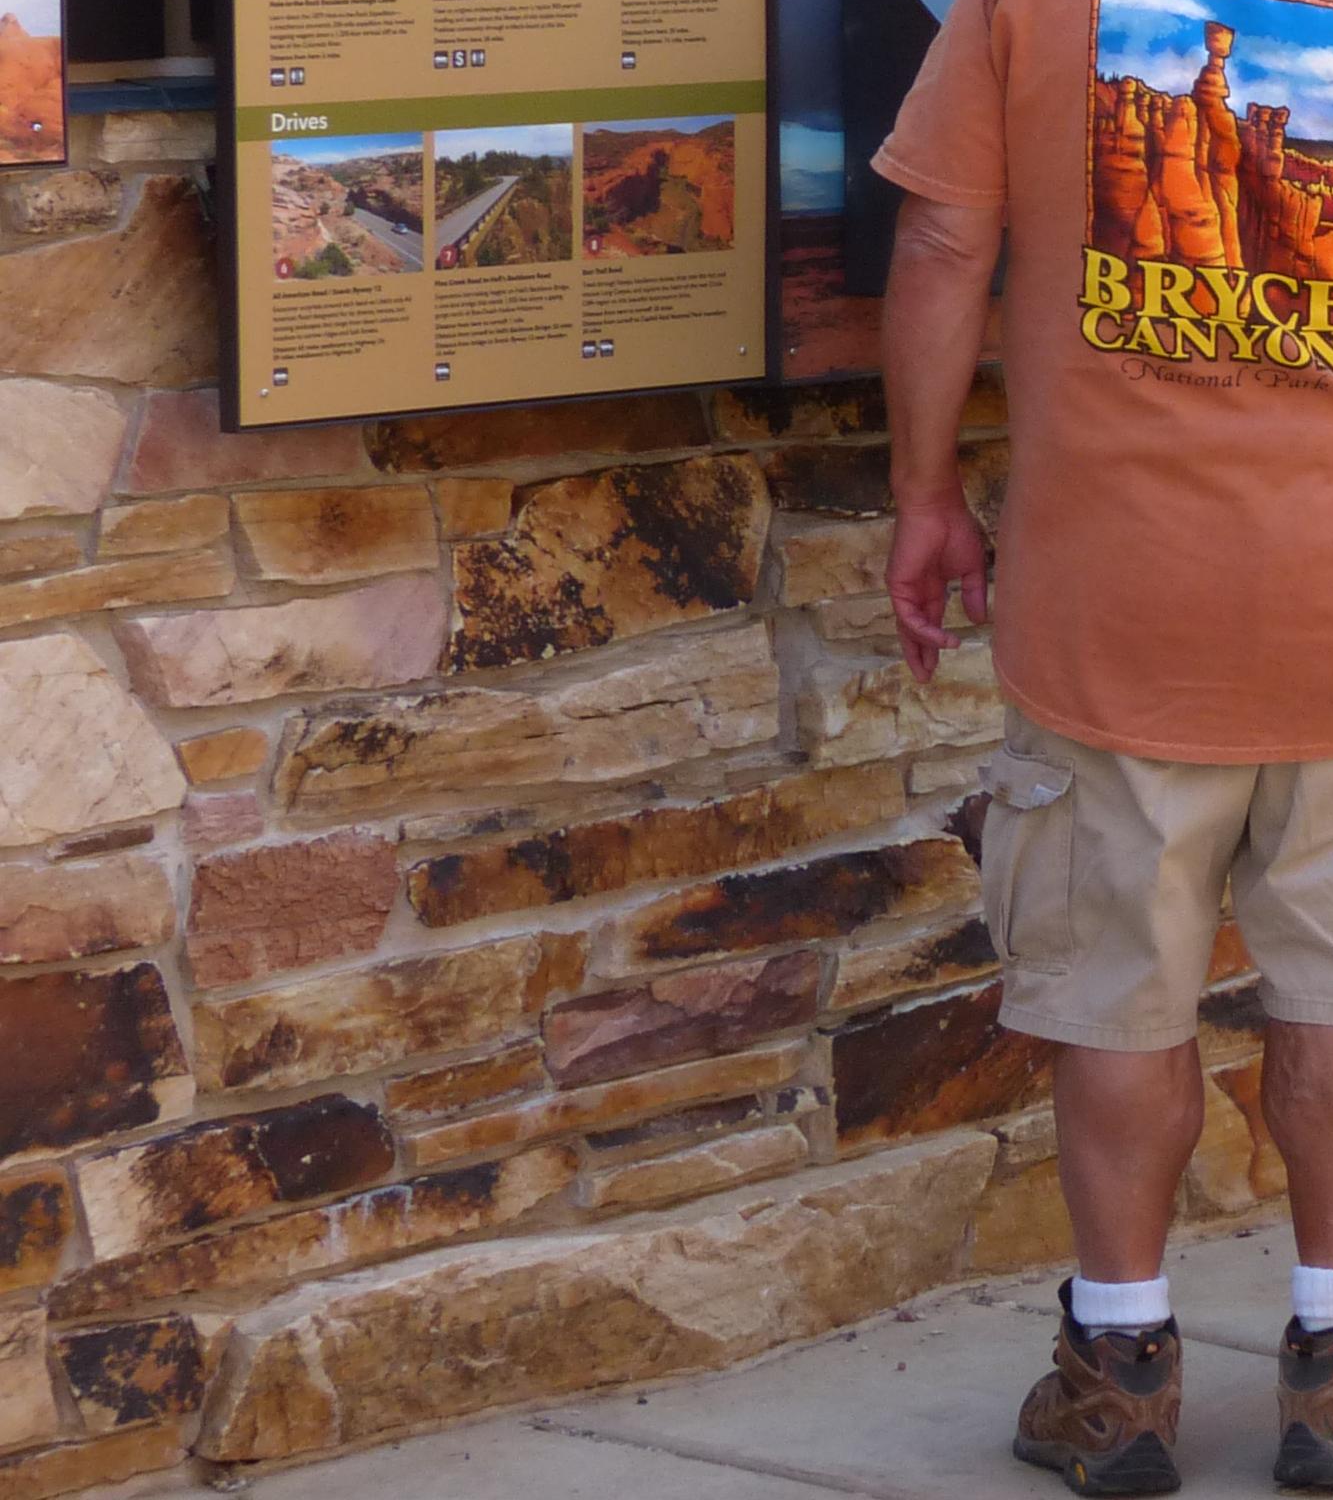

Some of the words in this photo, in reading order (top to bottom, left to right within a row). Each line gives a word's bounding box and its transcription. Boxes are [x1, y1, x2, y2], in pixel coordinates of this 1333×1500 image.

[271, 113, 328, 133] Drives
[1121, 357, 1244, 390] National
[1254, 368, 1330, 391] Park
